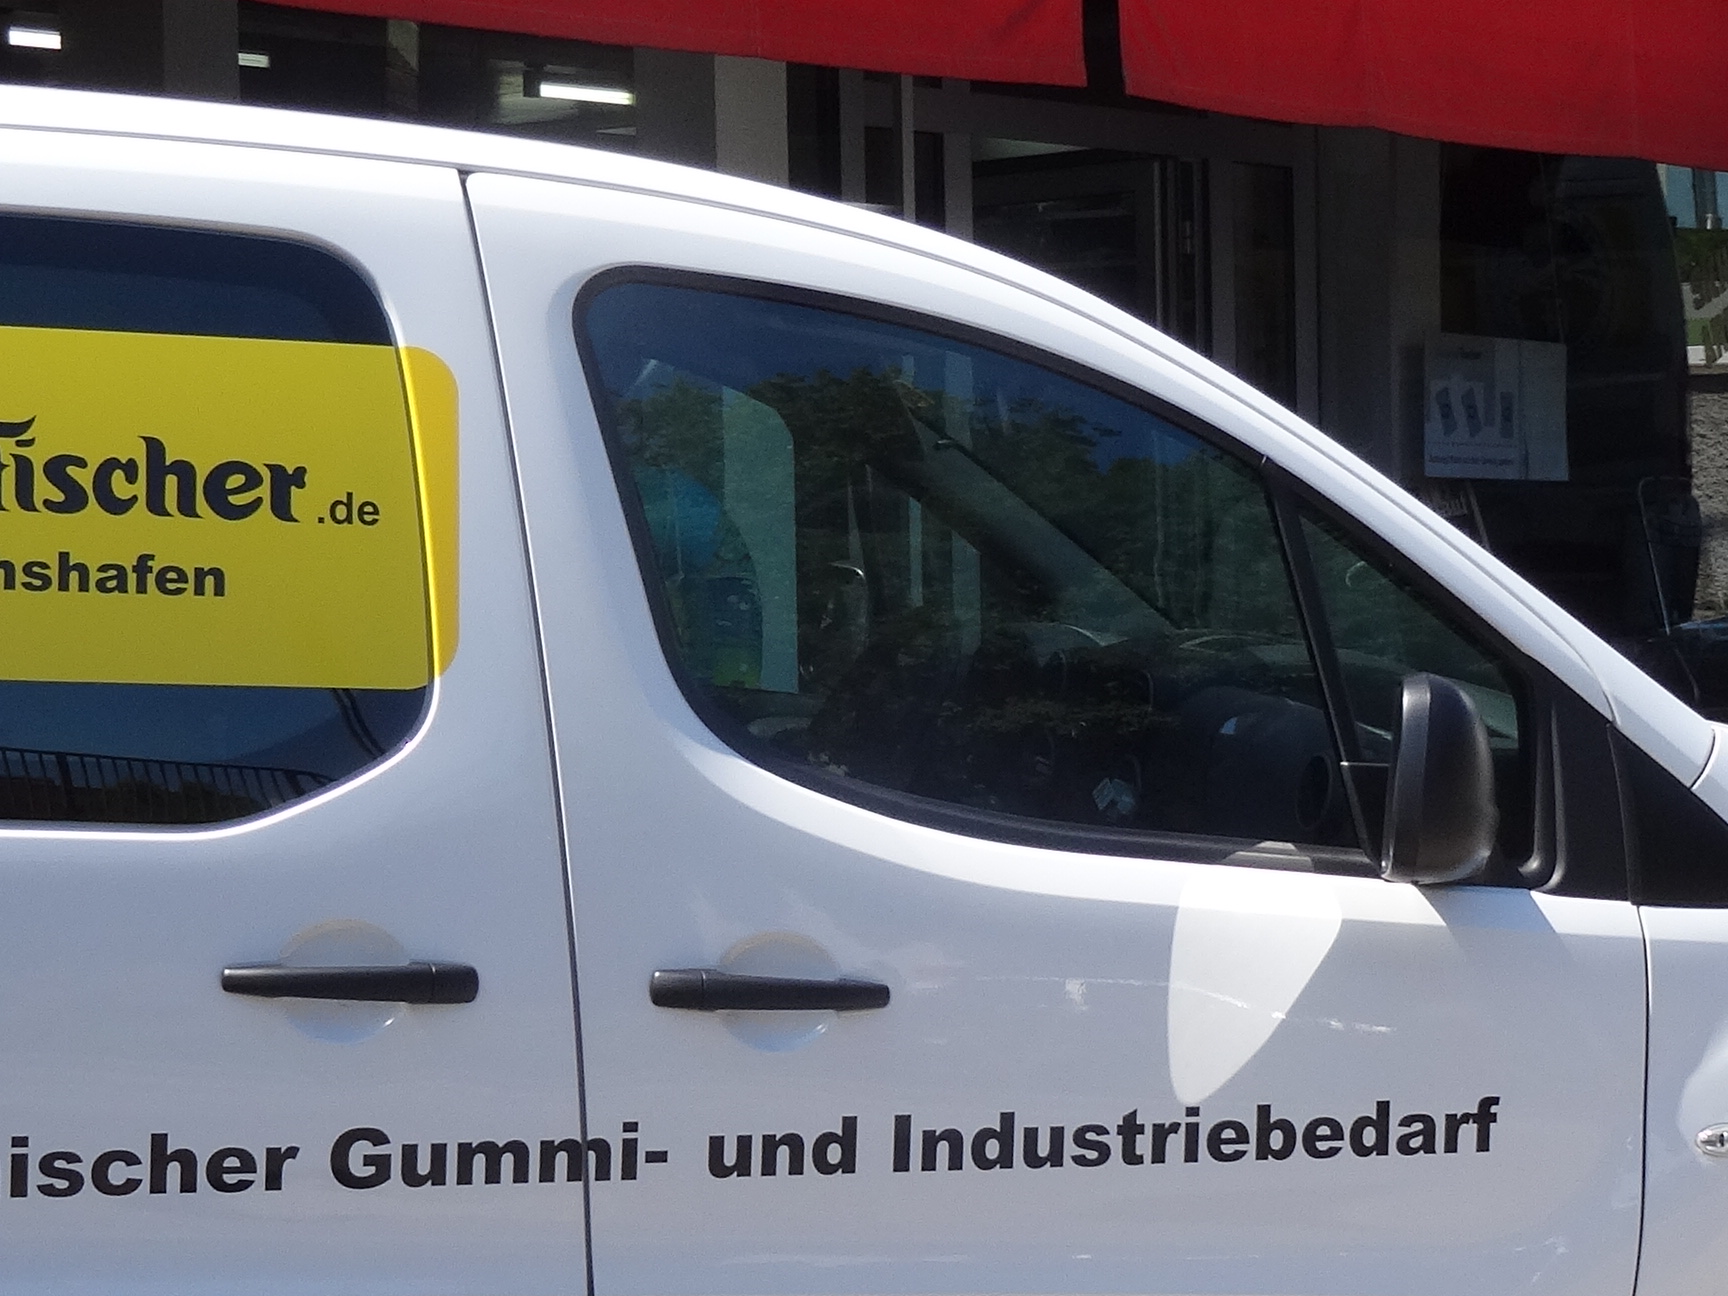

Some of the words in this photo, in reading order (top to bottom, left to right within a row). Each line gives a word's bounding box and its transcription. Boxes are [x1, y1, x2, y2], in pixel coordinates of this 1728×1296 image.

[329, 1120, 669, 1191] Gummi-
[707, 1115, 858, 1179] und
[893, 1096, 1501, 1174] Industriebedarf
